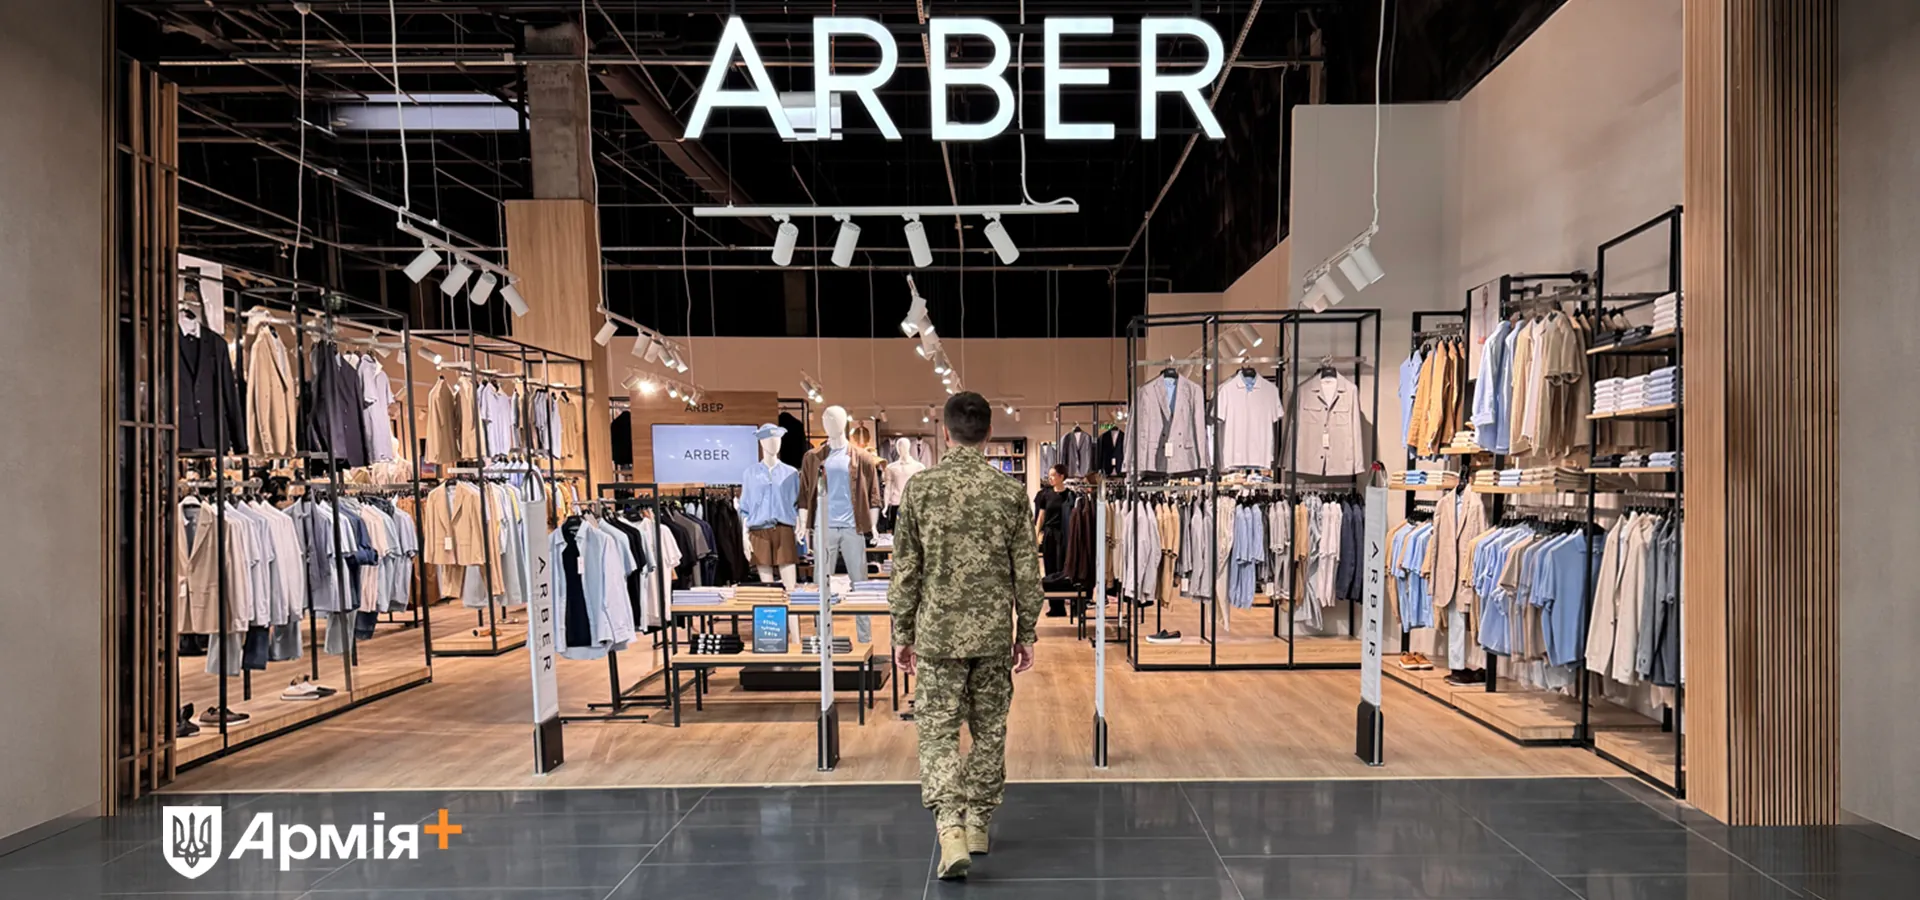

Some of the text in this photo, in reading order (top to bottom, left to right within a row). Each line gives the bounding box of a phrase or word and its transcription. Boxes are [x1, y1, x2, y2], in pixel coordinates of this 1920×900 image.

[684, 16, 1226, 140] ARBER
[684, 449, 730, 461] ARBER
[538, 556, 551, 672] ARBER
[1369, 541, 1379, 656] ARBER
